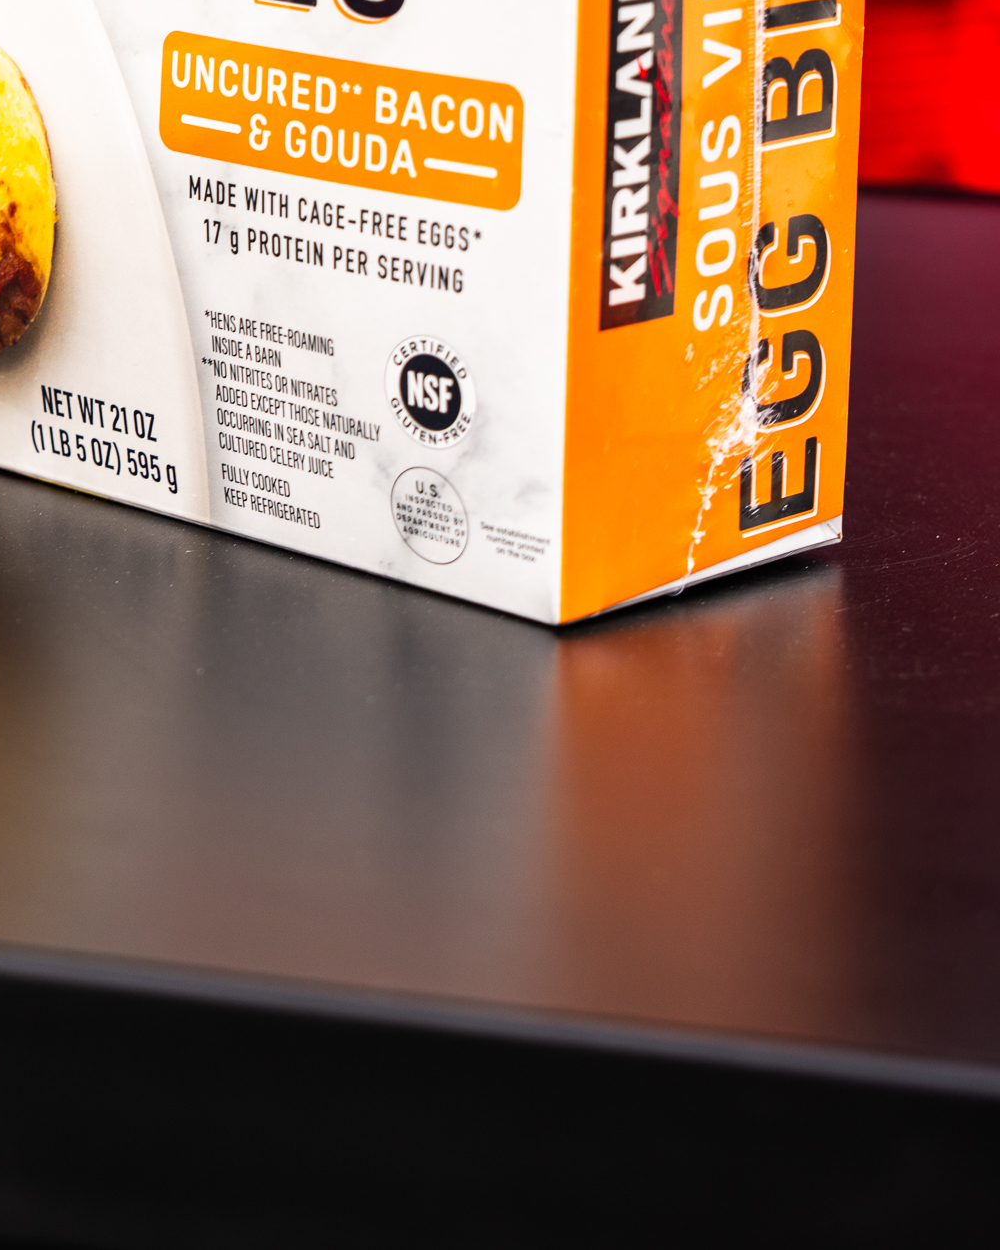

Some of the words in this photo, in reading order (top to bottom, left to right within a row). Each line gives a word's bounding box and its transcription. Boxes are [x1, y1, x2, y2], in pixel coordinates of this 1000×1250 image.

[375, 86, 514, 143] BACON
[249, 113, 271, 151] &
[285, 120, 417, 178] GOUDA
[189, 175, 237, 208] MADE
[245, 186, 290, 219] WITH
[299, 198, 408, 241] CAGE-FREE
[693, 114, 742, 331] SOUS
[203, 218, 222, 244] 17
[230, 230, 239, 254] g
[248, 228, 324, 267] PROTEIN
[333, 246, 368, 276] PER
[378, 255, 464, 293] SERVING
[212, 335, 243, 358] INSIDE
[246, 343, 252, 361] A
[255, 345, 281, 368] BARN
[239, 318, 258, 338] ARE
[260, 322, 334, 356] FREE-ROAMING
[393, 340, 467, 380] CERTIFIED
[739, 213, 831, 538] EGG
[230, 363, 273, 390] NITRITES
[275, 375, 288, 395] OR
[291, 379, 338, 407] NITRATES
[407, 370, 454, 413] NSF
[41, 385, 72, 419] NET
[77, 394, 105, 428] WT
[110, 404, 129, 434] 21
[133, 410, 157, 442] OZ
[216, 384, 248, 407] ADDED
[251, 393, 286, 417] EXCEPT
[288, 402, 320, 427] THOSE
[323, 411, 380, 442] NATURALLY
[217, 408, 271, 438] OCCURRING
[274, 422, 284, 441] IN
[287, 427, 305, 446] SEA
[308, 432, 331, 454] SALT
[334, 440, 355, 459] AND
[390, 398, 473, 445] GLUTEN-FREE
[31, 420, 45, 453] (1
[49, 426, 71, 457] LB
[76, 434, 86, 462] 5
[91, 438, 121, 475] OZ)
[127, 448, 161, 483] 595
[166, 464, 178, 494] g
[219, 432, 267, 460] CULTURED
[270, 446, 305, 470] CELERY
[308, 456, 334, 478] JUICE
[222, 463, 249, 486] FULLY
[252, 471, 291, 497] COOKED
[415, 480, 441, 498] U.S.
[224, 486, 247, 507] KEEP
[250, 494, 320, 529] REFRIGERATED
[396, 502, 412, 513] AND
[416, 508, 449, 522] PASSED
[453, 518, 463, 526] BY
[396, 513, 451, 533] DEPARTMENT
[455, 529, 465, 537] OF
[405, 494, 452, 512] INSPECTED
[403, 526, 460, 547] AGRICULTURE
